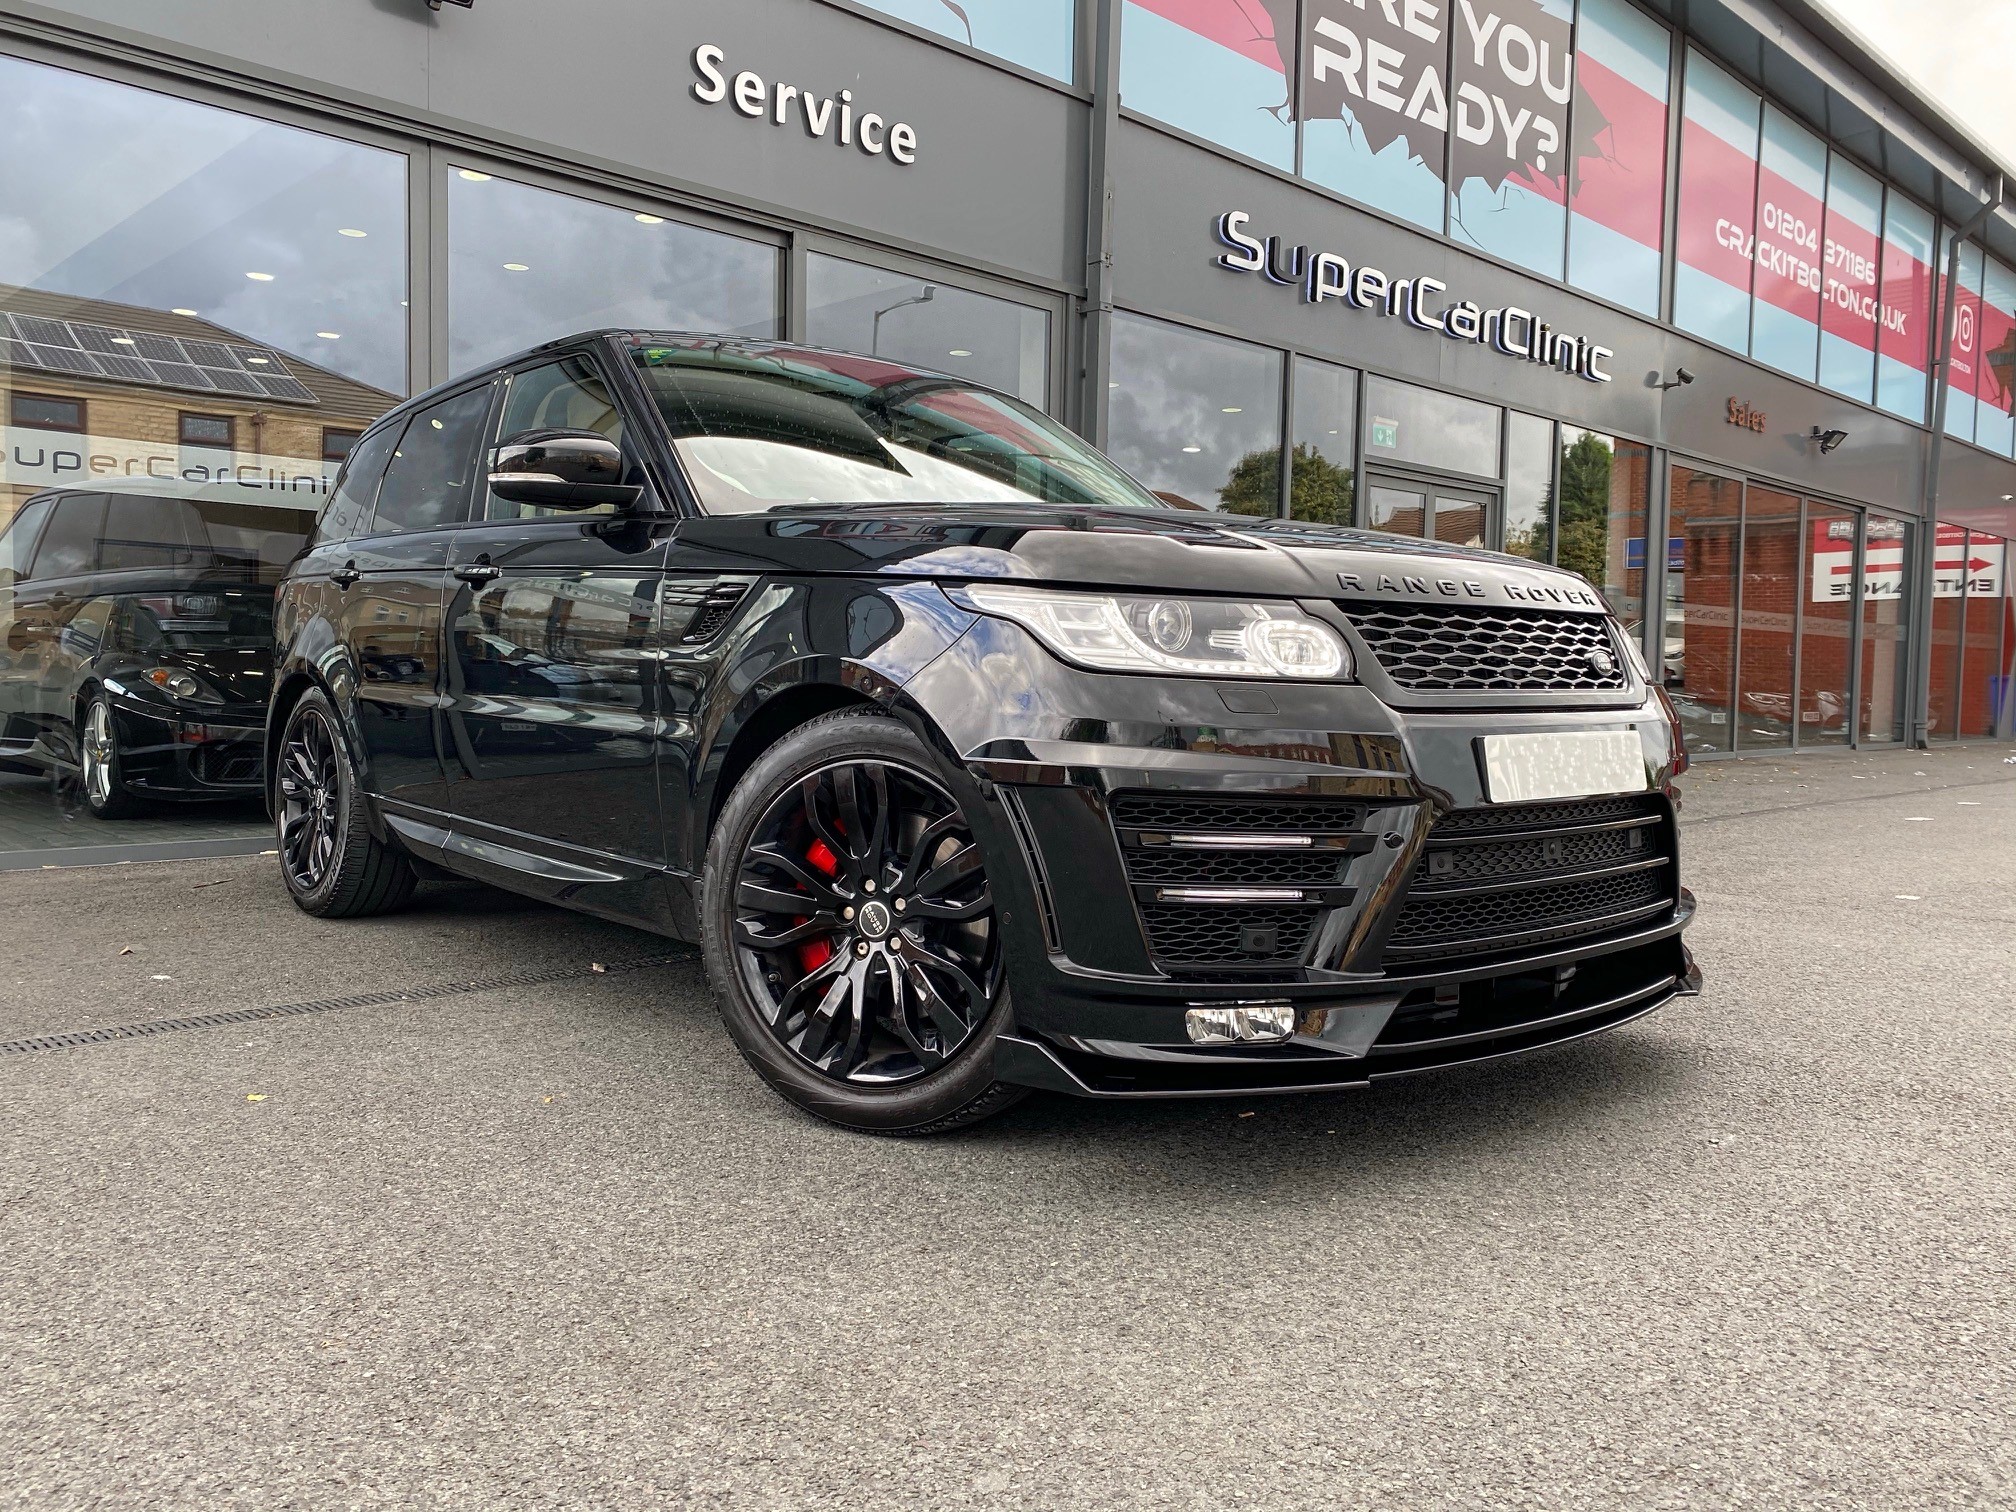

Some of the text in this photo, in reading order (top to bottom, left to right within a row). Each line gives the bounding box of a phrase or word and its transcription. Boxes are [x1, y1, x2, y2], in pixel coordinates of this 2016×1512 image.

[1313, 16, 1559, 172] READY?
[1459, 0, 1572, 105] YOU
[694, 43, 917, 164] Service
[1763, 202, 1876, 286] 01204 371186
[1218, 210, 1614, 383] SuperCarClinic
[1727, 395, 1766, 433] Sales
[0, 446, 328, 495] uperCarClini
[1336, 572, 1597, 606] RANGE ROVER
